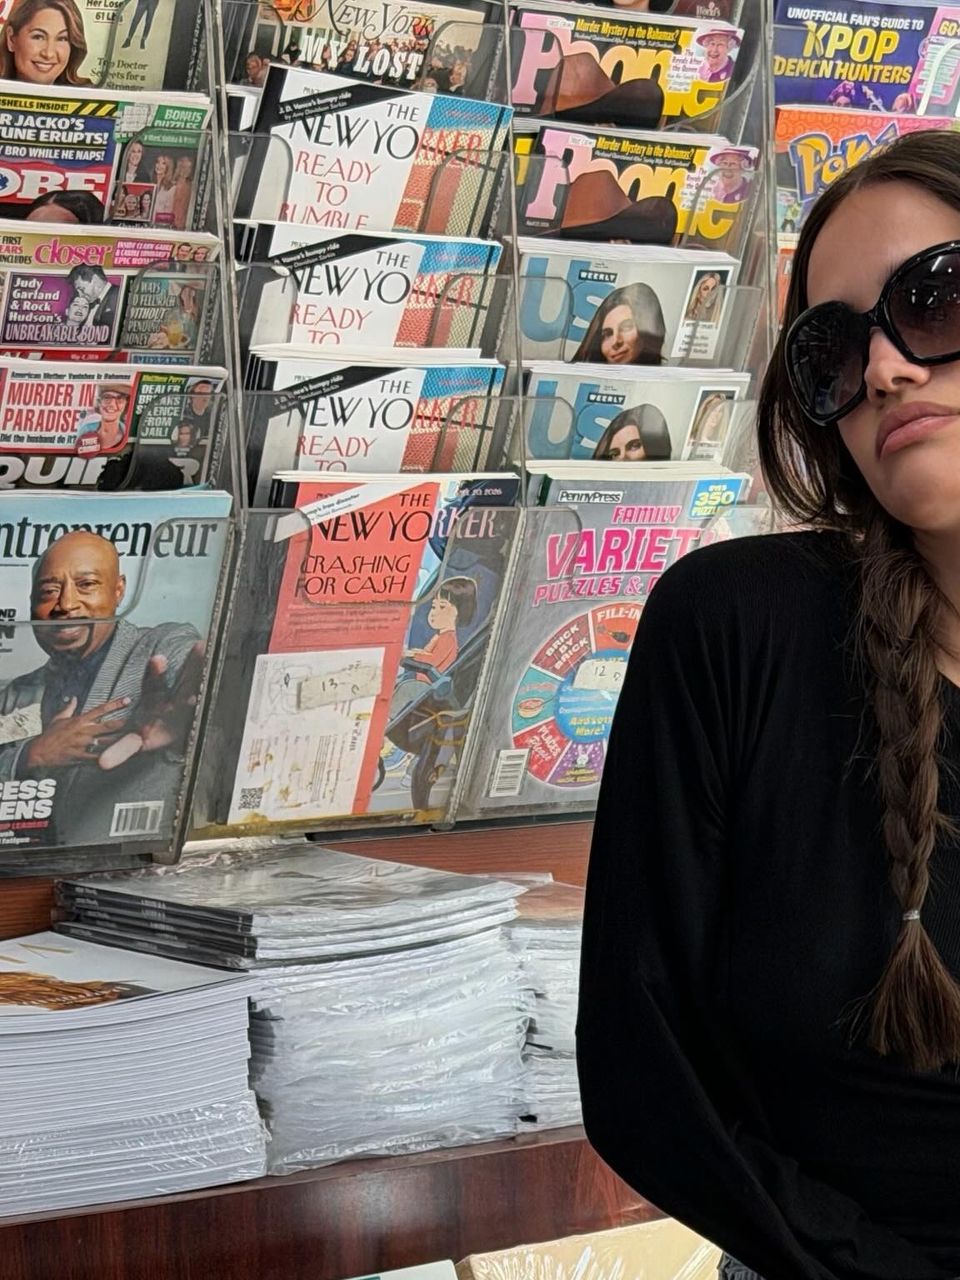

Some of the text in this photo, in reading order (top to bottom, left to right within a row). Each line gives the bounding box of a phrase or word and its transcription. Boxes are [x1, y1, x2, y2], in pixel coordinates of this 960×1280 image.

[787, 7, 924, 31] UNOFFICIAL FAN'S GUIDE TO
[802, 20, 900, 62] KPOP
[117, 61, 148, 70] Doctor
[300, 35, 424, 80] MY LOST
[834, 59, 912, 85] HUNTERS
[36, 102, 69, 111] INSIDE!
[165, 109, 202, 121] BONUS
[386, 103, 420, 122] THE
[14, 115, 85, 130] JACKO'S
[289, 113, 369, 149] NEW
[39, 130, 109, 144] ERUPTS!
[6, 146, 105, 161] BRO WHILE HE NAPS!
[295, 151, 381, 186] READY
[316, 181, 348, 207] TO
[2, 236, 21, 245] FIRST
[34, 238, 113, 266] closer
[376, 251, 410, 269] THE
[14, 278, 42, 293] Judy
[281, 264, 358, 296] NEW
[580, 271, 617, 281] WEEKLY
[13, 289, 60, 300] Garland
[10, 301, 51, 311] & Rock
[9, 313, 62, 324] Hudson's
[290, 303, 373, 331] READY
[5, 324, 109, 342] UNBREAKABLE BOND
[7, 383, 97, 407] MURDER IN
[380, 380, 412, 394] THE
[589, 394, 626, 404] WEEKLY
[2, 409, 80, 432] PARADISE
[287, 397, 362, 428] NEW
[296, 436, 377, 457] READY
[400, 493, 431, 507] THE
[697, 491, 734, 506] 350
[612, 505, 682, 524] FAMILY
[317, 507, 497, 543] NEW YORKER
[303, 554, 411, 575] CRASHING
[296, 576, 407, 597] FOR CASH
[532, 576, 644, 607] PUZZLES &
[545, 624, 580, 658] BRICK
[559, 638, 575, 654] BY
[554, 637, 590, 670] BRICK
